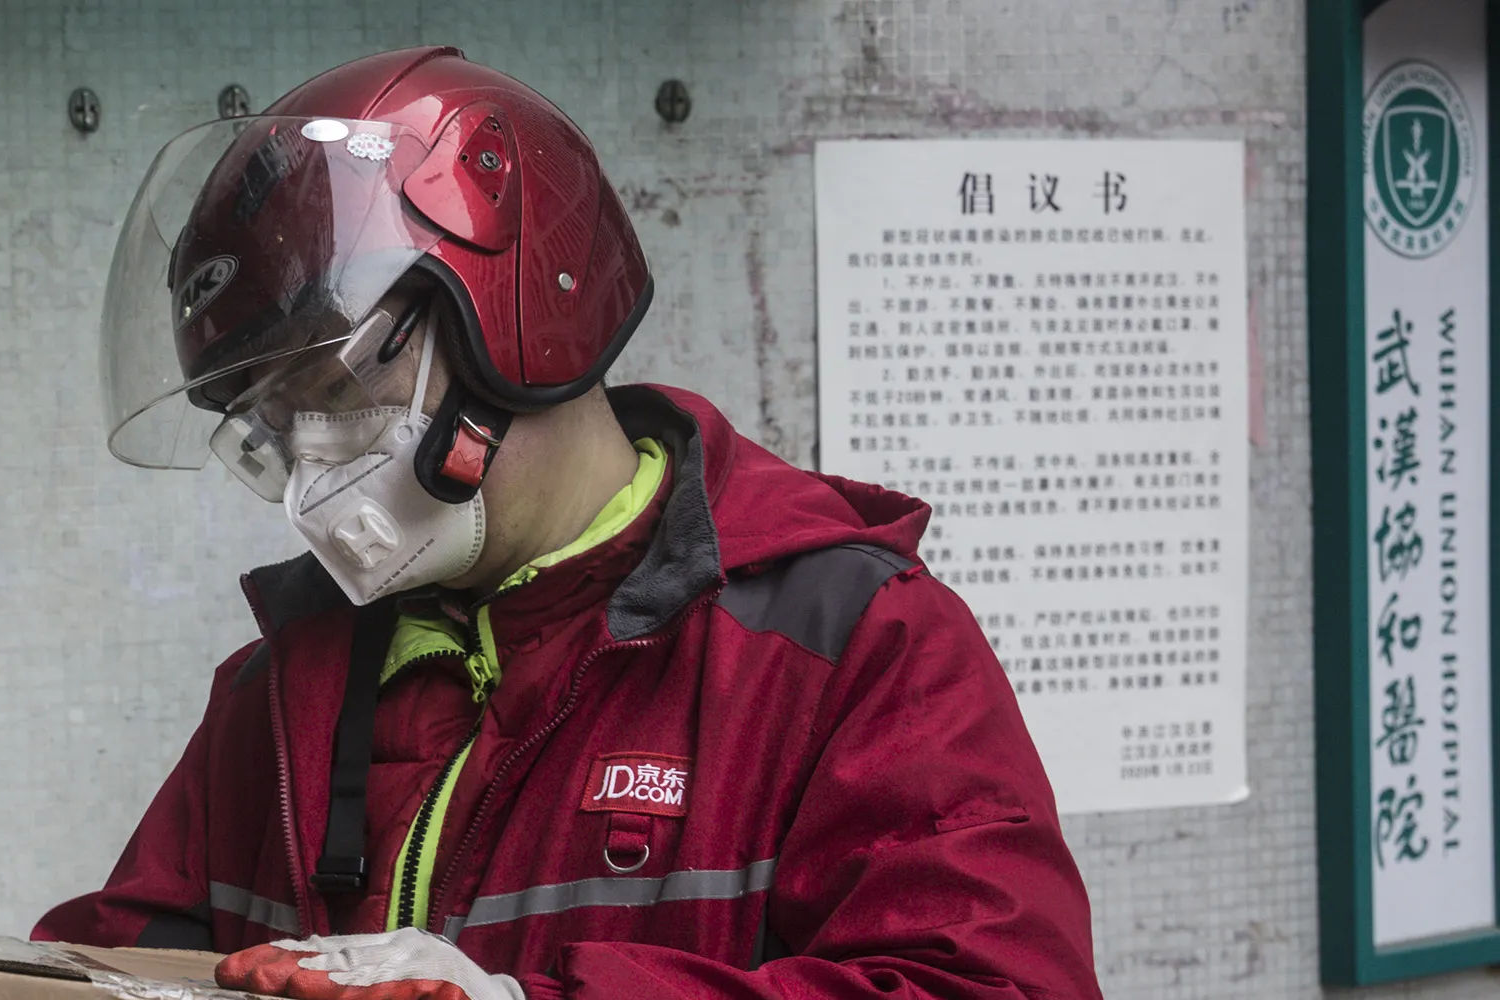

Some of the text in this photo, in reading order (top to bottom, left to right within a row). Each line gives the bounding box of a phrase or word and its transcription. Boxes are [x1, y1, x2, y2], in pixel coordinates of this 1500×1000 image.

[958, 170, 1129, 216] 倡议书
[1437, 307, 1461, 858] WUHAN UNION HOSPITAL
[635, 763, 689, 790] 京东
